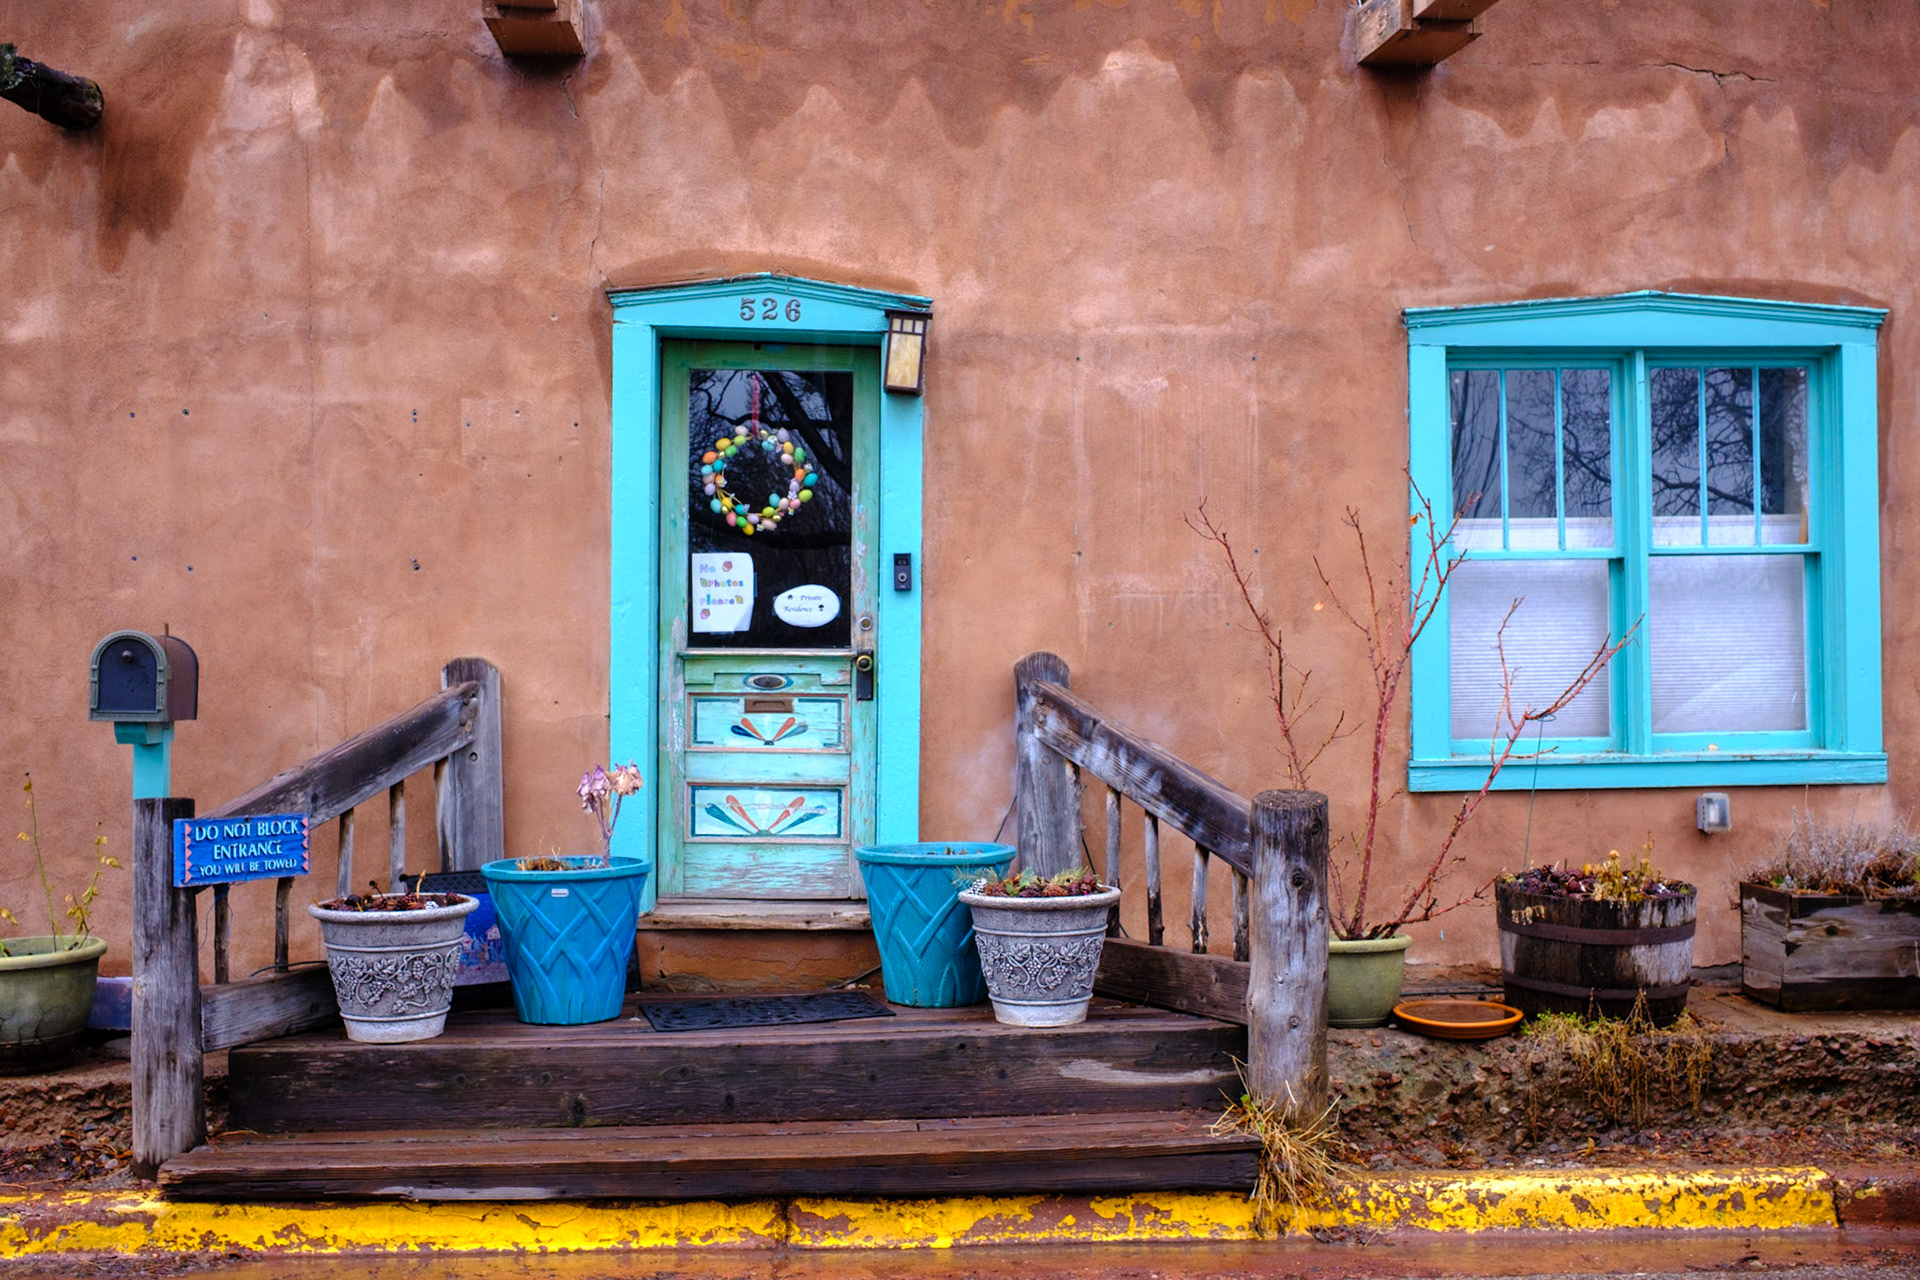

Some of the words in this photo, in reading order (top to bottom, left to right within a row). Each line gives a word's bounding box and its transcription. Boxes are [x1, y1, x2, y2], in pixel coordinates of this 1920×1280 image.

[740, 297, 801, 322] 526
[699, 564, 715, 573] No
[195, 825, 219, 841] DO
[223, 822, 251, 838] NOT
[257, 819, 300, 836] BLOCK
[213, 840, 283, 860] ENTRANCE
[199, 864, 221, 876] YOU
[224, 862, 246, 874] WILL
[249, 860, 260, 872] BE
[263, 858, 297, 871] TOWED
